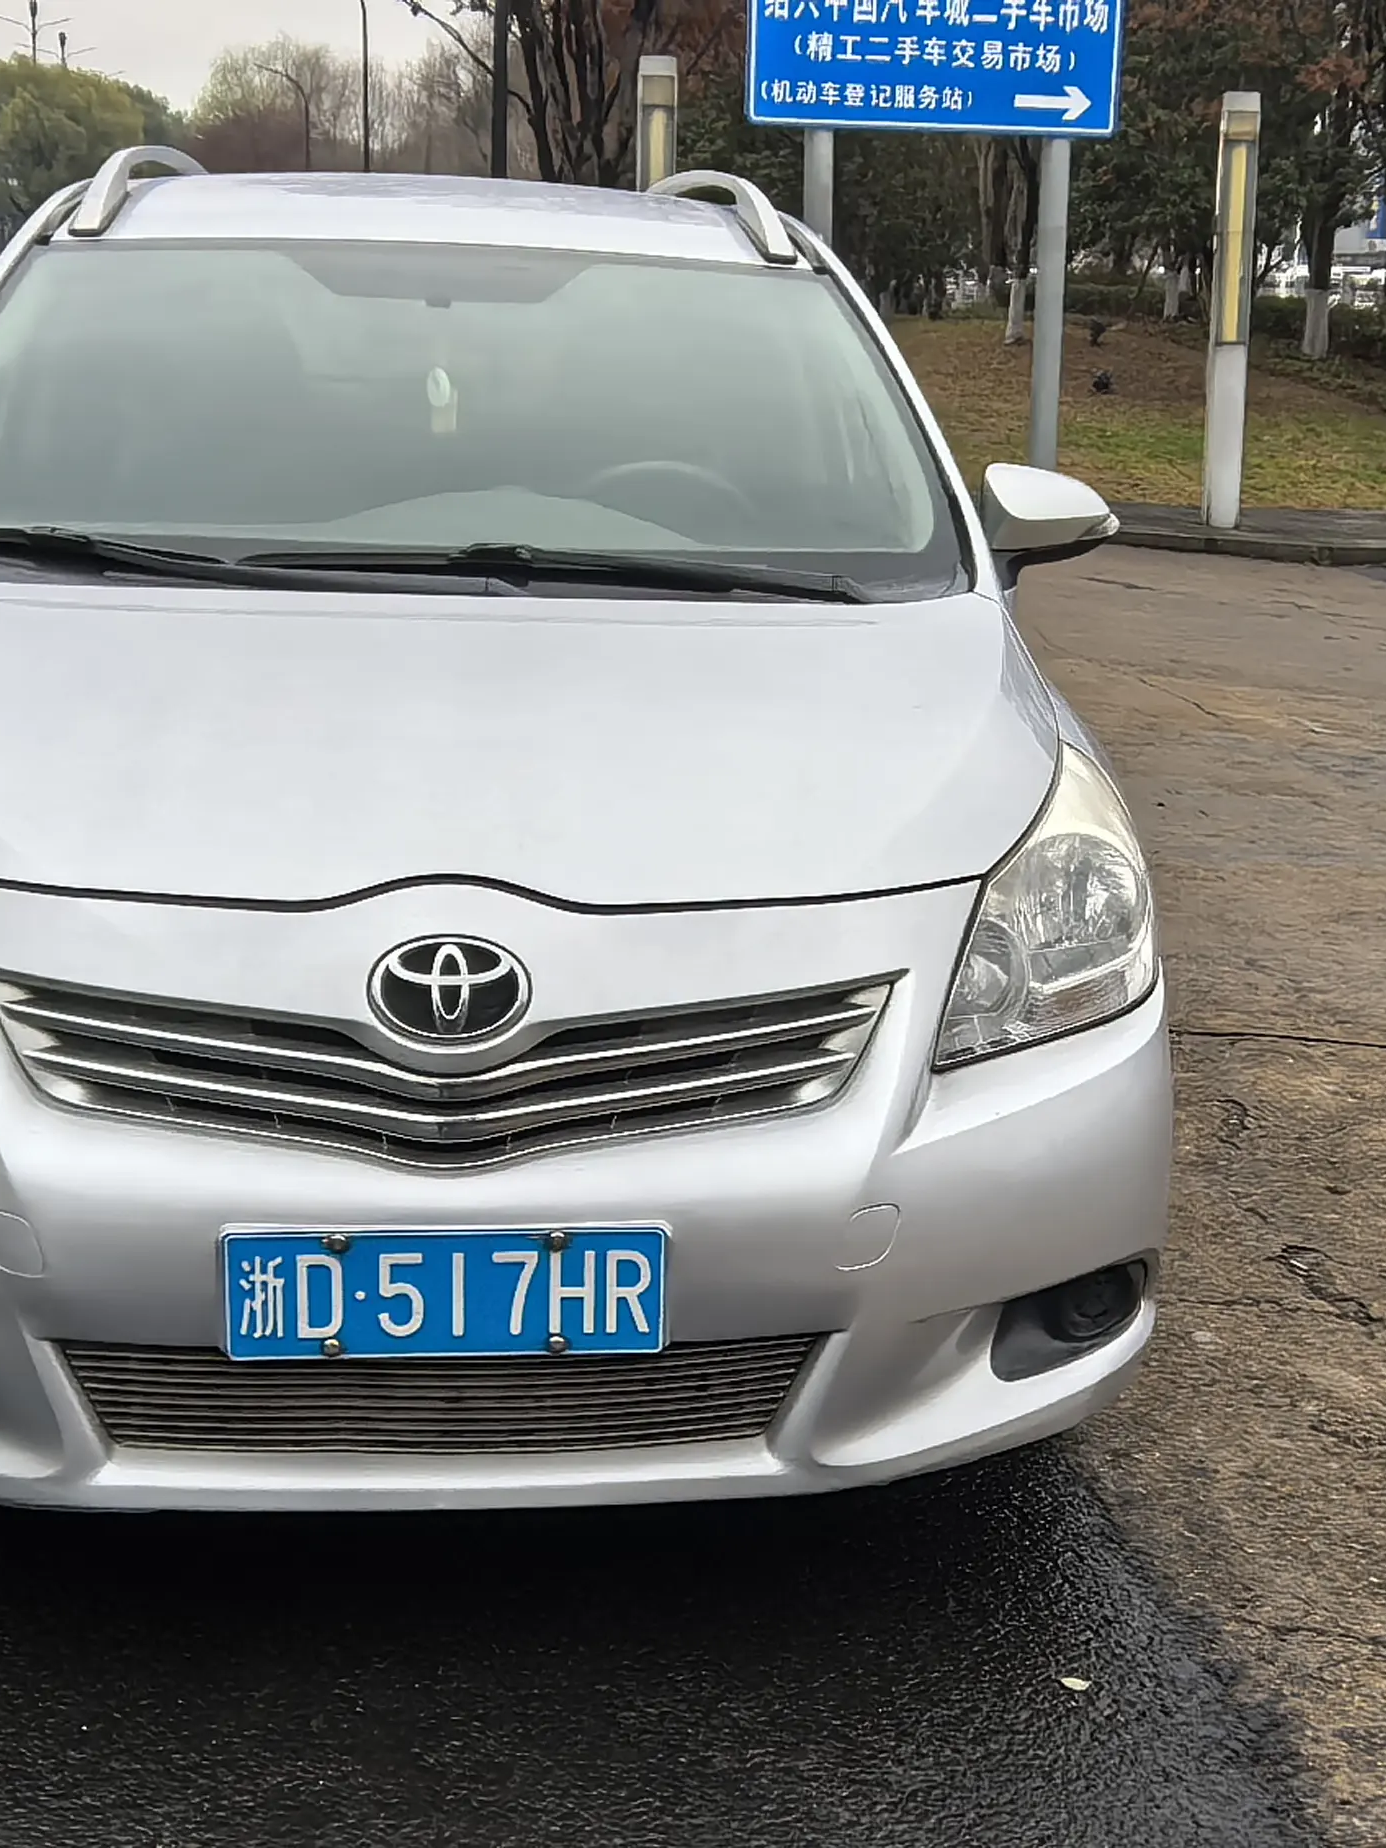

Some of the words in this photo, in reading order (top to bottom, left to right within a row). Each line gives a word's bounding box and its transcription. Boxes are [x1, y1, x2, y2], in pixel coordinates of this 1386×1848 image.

[794, 30, 1076, 73] （精工二手车交易市场）
[760, 78, 973, 110] （机动车登记服务站）
[239, 1250, 652, 1339] 浙D·517HR
